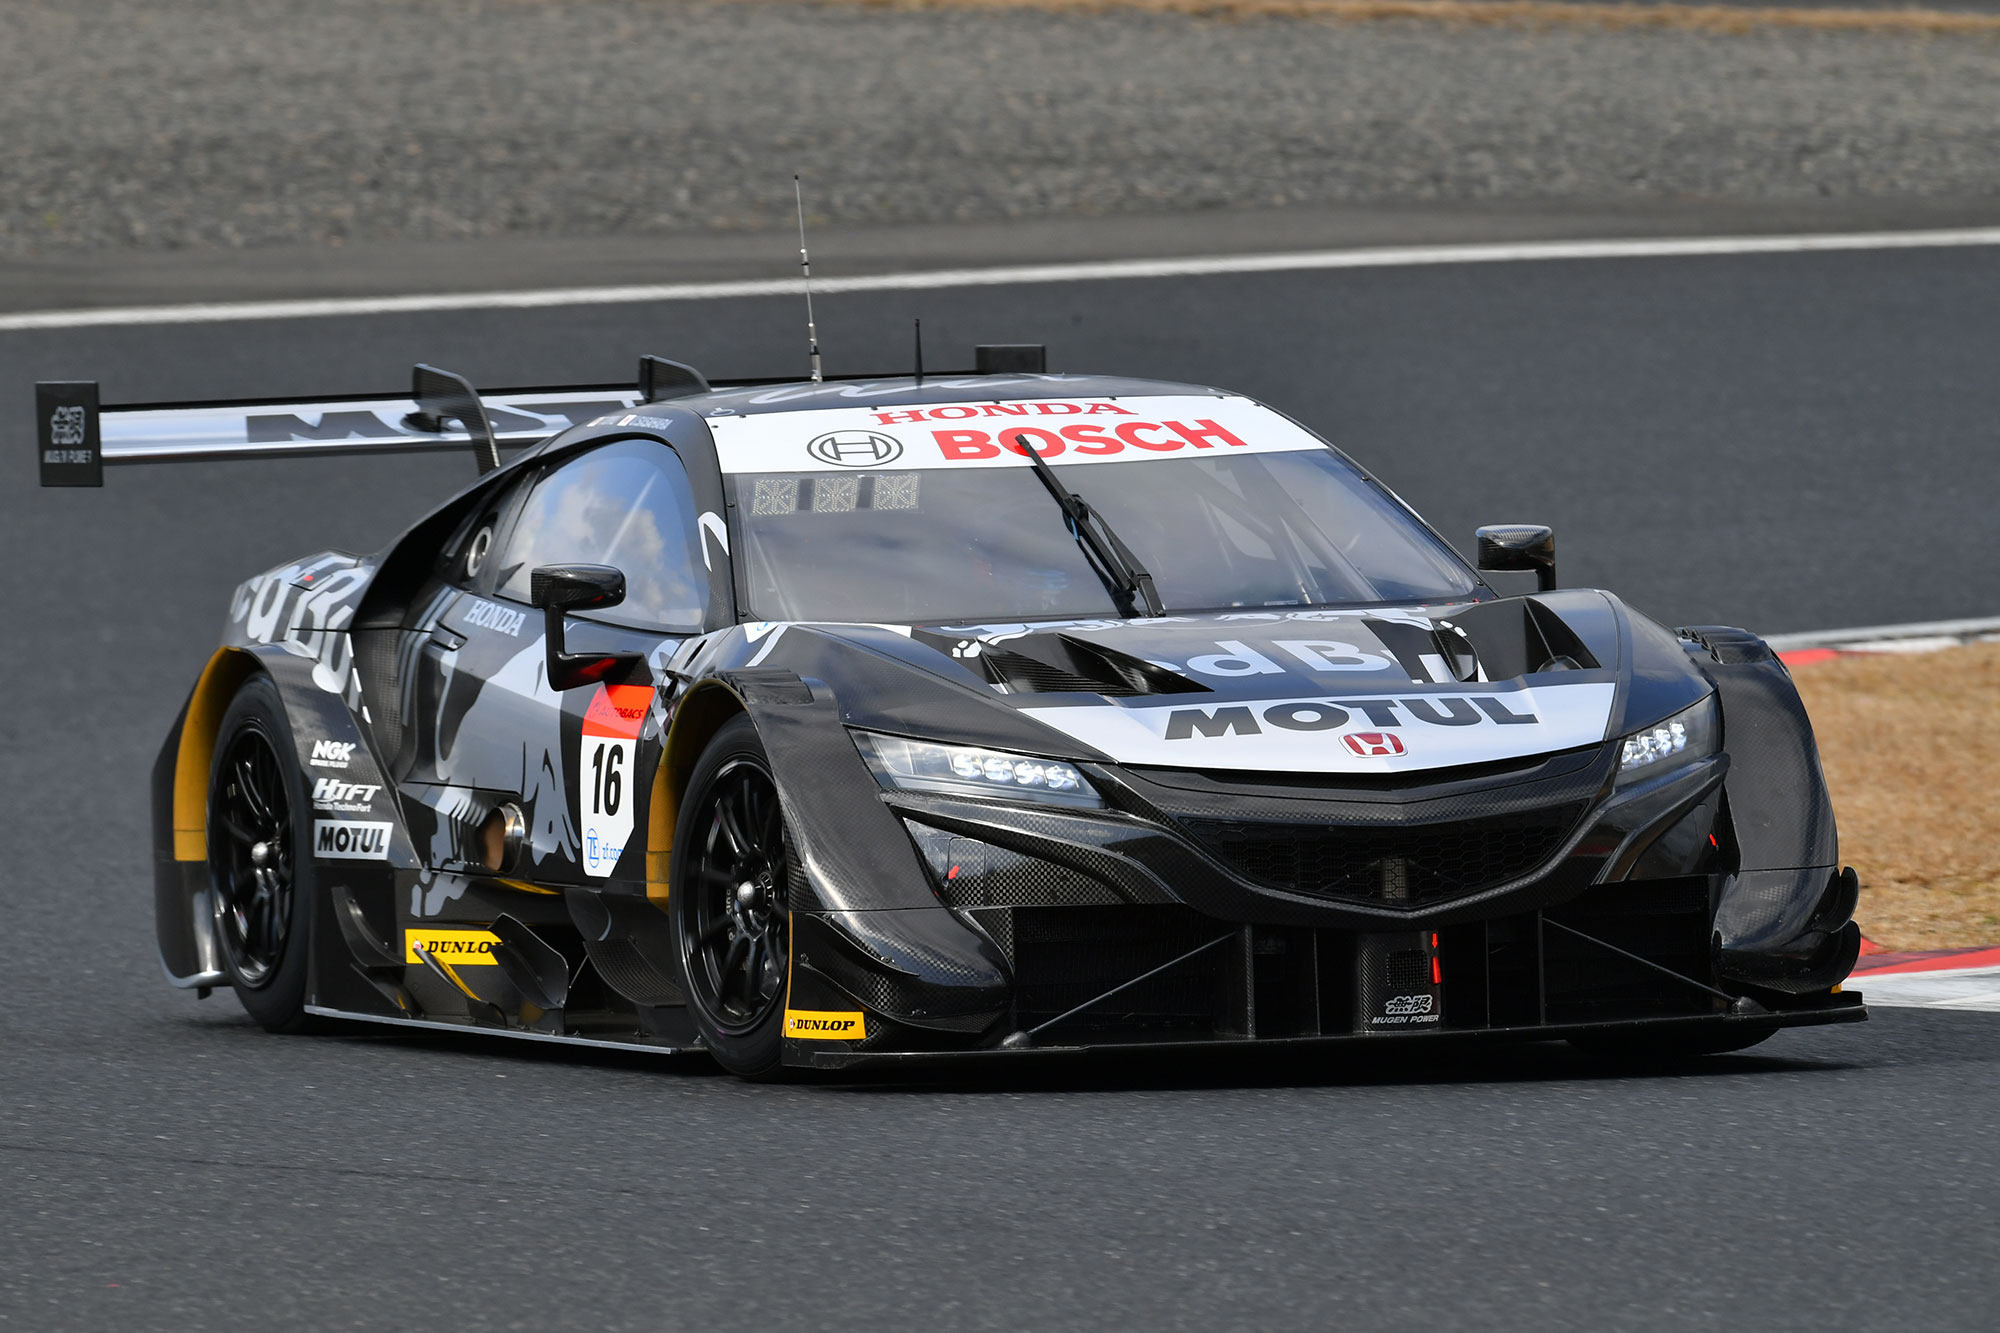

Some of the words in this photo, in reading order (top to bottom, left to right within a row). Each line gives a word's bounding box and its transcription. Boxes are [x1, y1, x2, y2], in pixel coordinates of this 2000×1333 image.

[870, 402, 1139, 425] HONDA
[931, 418, 1248, 461] BOSCH
[463, 600, 526, 637] HONDA
[1164, 697, 1538, 740] MOTUL
[312, 740, 356, 761] NGK
[592, 743, 624, 816] 16
[318, 826, 384, 853] MOTUL
[428, 941, 503, 953] DUNLO
[796, 1019, 855, 1031] DUNLOP
[1372, 1015, 1408, 1024] MUGEN
[1410, 1014, 1439, 1023] POWER
